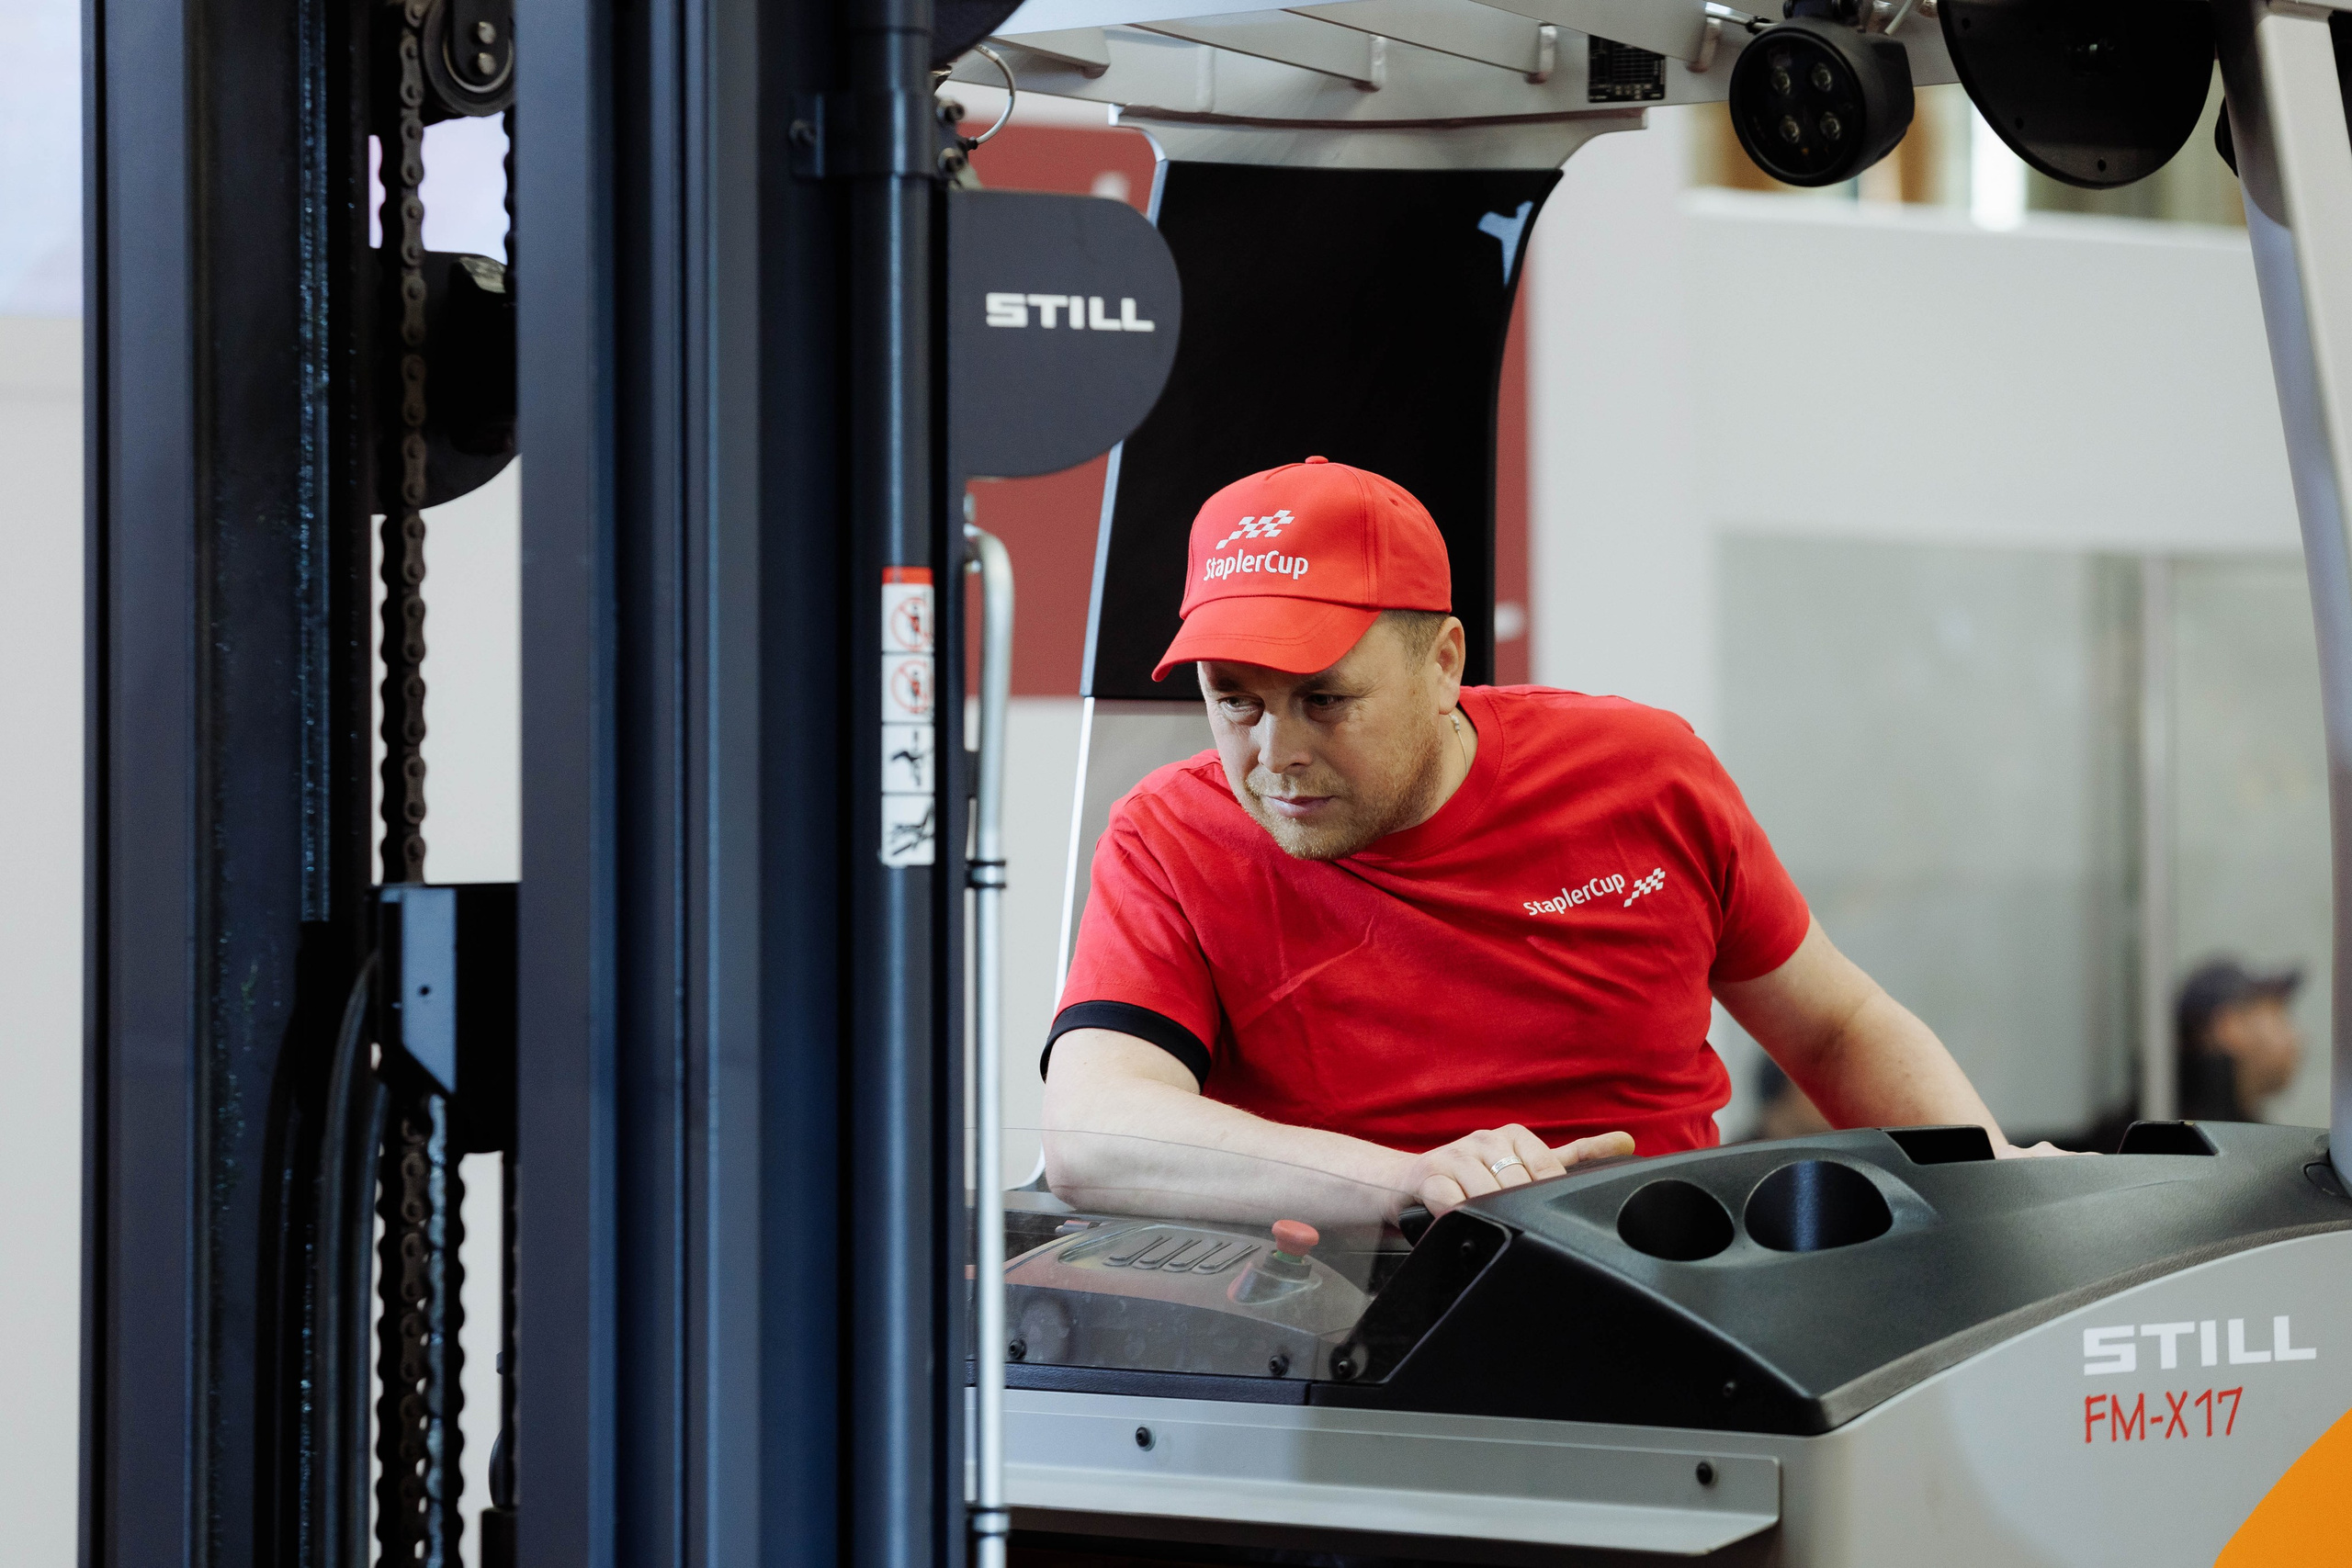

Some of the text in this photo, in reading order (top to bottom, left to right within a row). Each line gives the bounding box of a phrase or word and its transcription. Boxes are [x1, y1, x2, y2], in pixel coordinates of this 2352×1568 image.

[986, 292, 1155, 333] STILL
[1204, 548, 1309, 581] StaplerCup
[1523, 874, 1625, 916] StaplerCup
[2083, 1315, 2317, 1376] STILL
